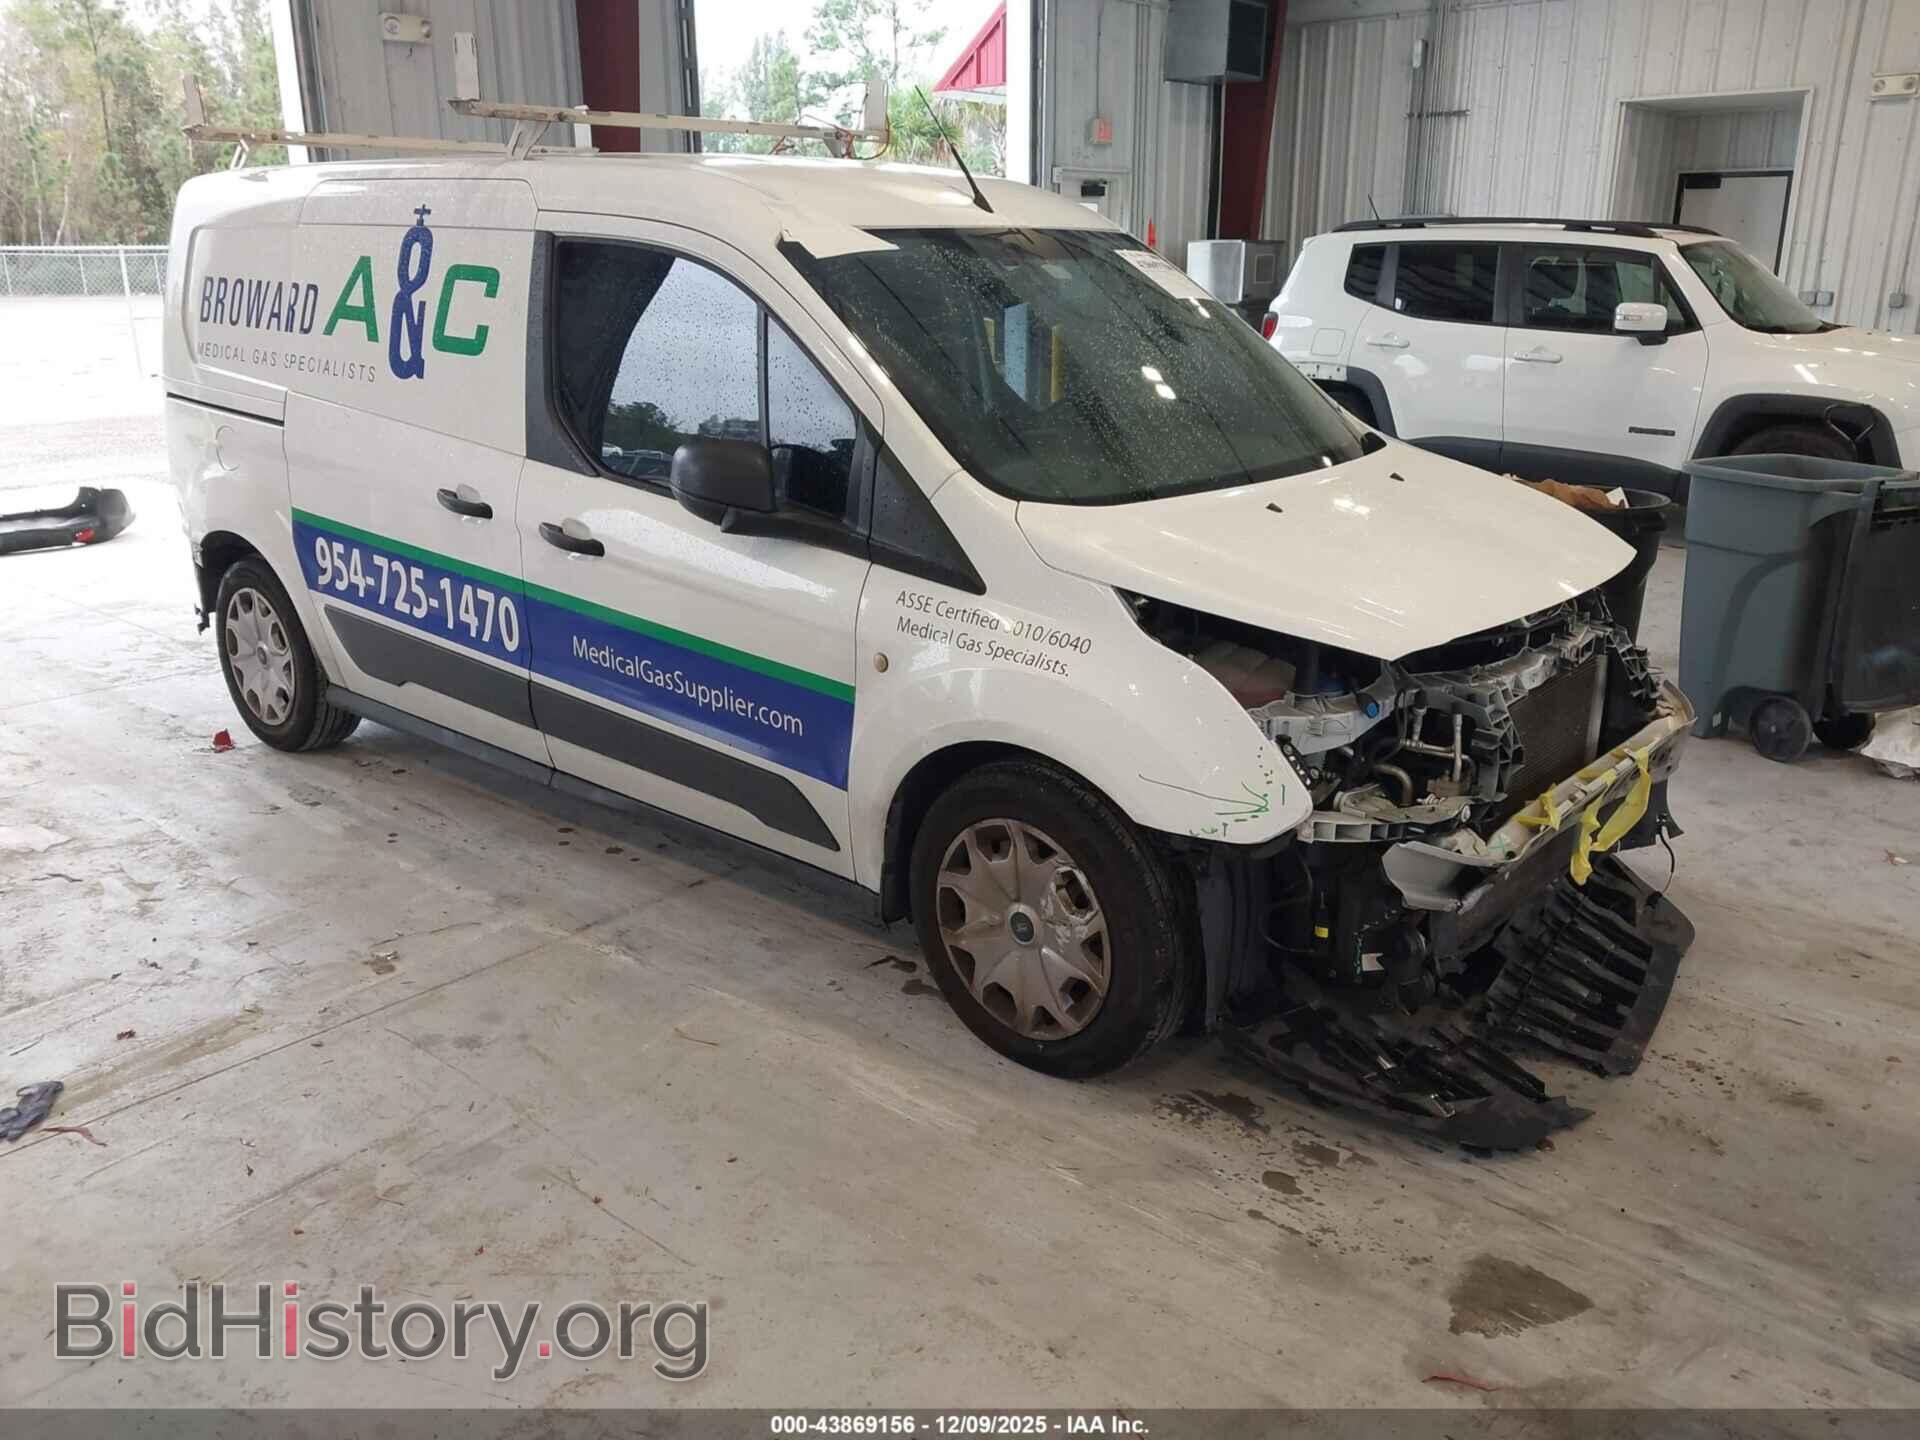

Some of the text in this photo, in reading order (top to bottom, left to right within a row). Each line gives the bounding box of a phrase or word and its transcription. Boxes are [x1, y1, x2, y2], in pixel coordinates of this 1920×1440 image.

[200, 276, 319, 336] BROWARD
[198, 341, 376, 383] MEDICAL GAS SPECIALISTS
[314, 536, 519, 652] 954-725-1470
[896, 590, 933, 613] ASSE
[1003, 618, 1092, 655] 010/6040
[896, 616, 1070, 677] Medical Gas Specialists.
[572, 634, 804, 737] MedicalGasSupplier.com
